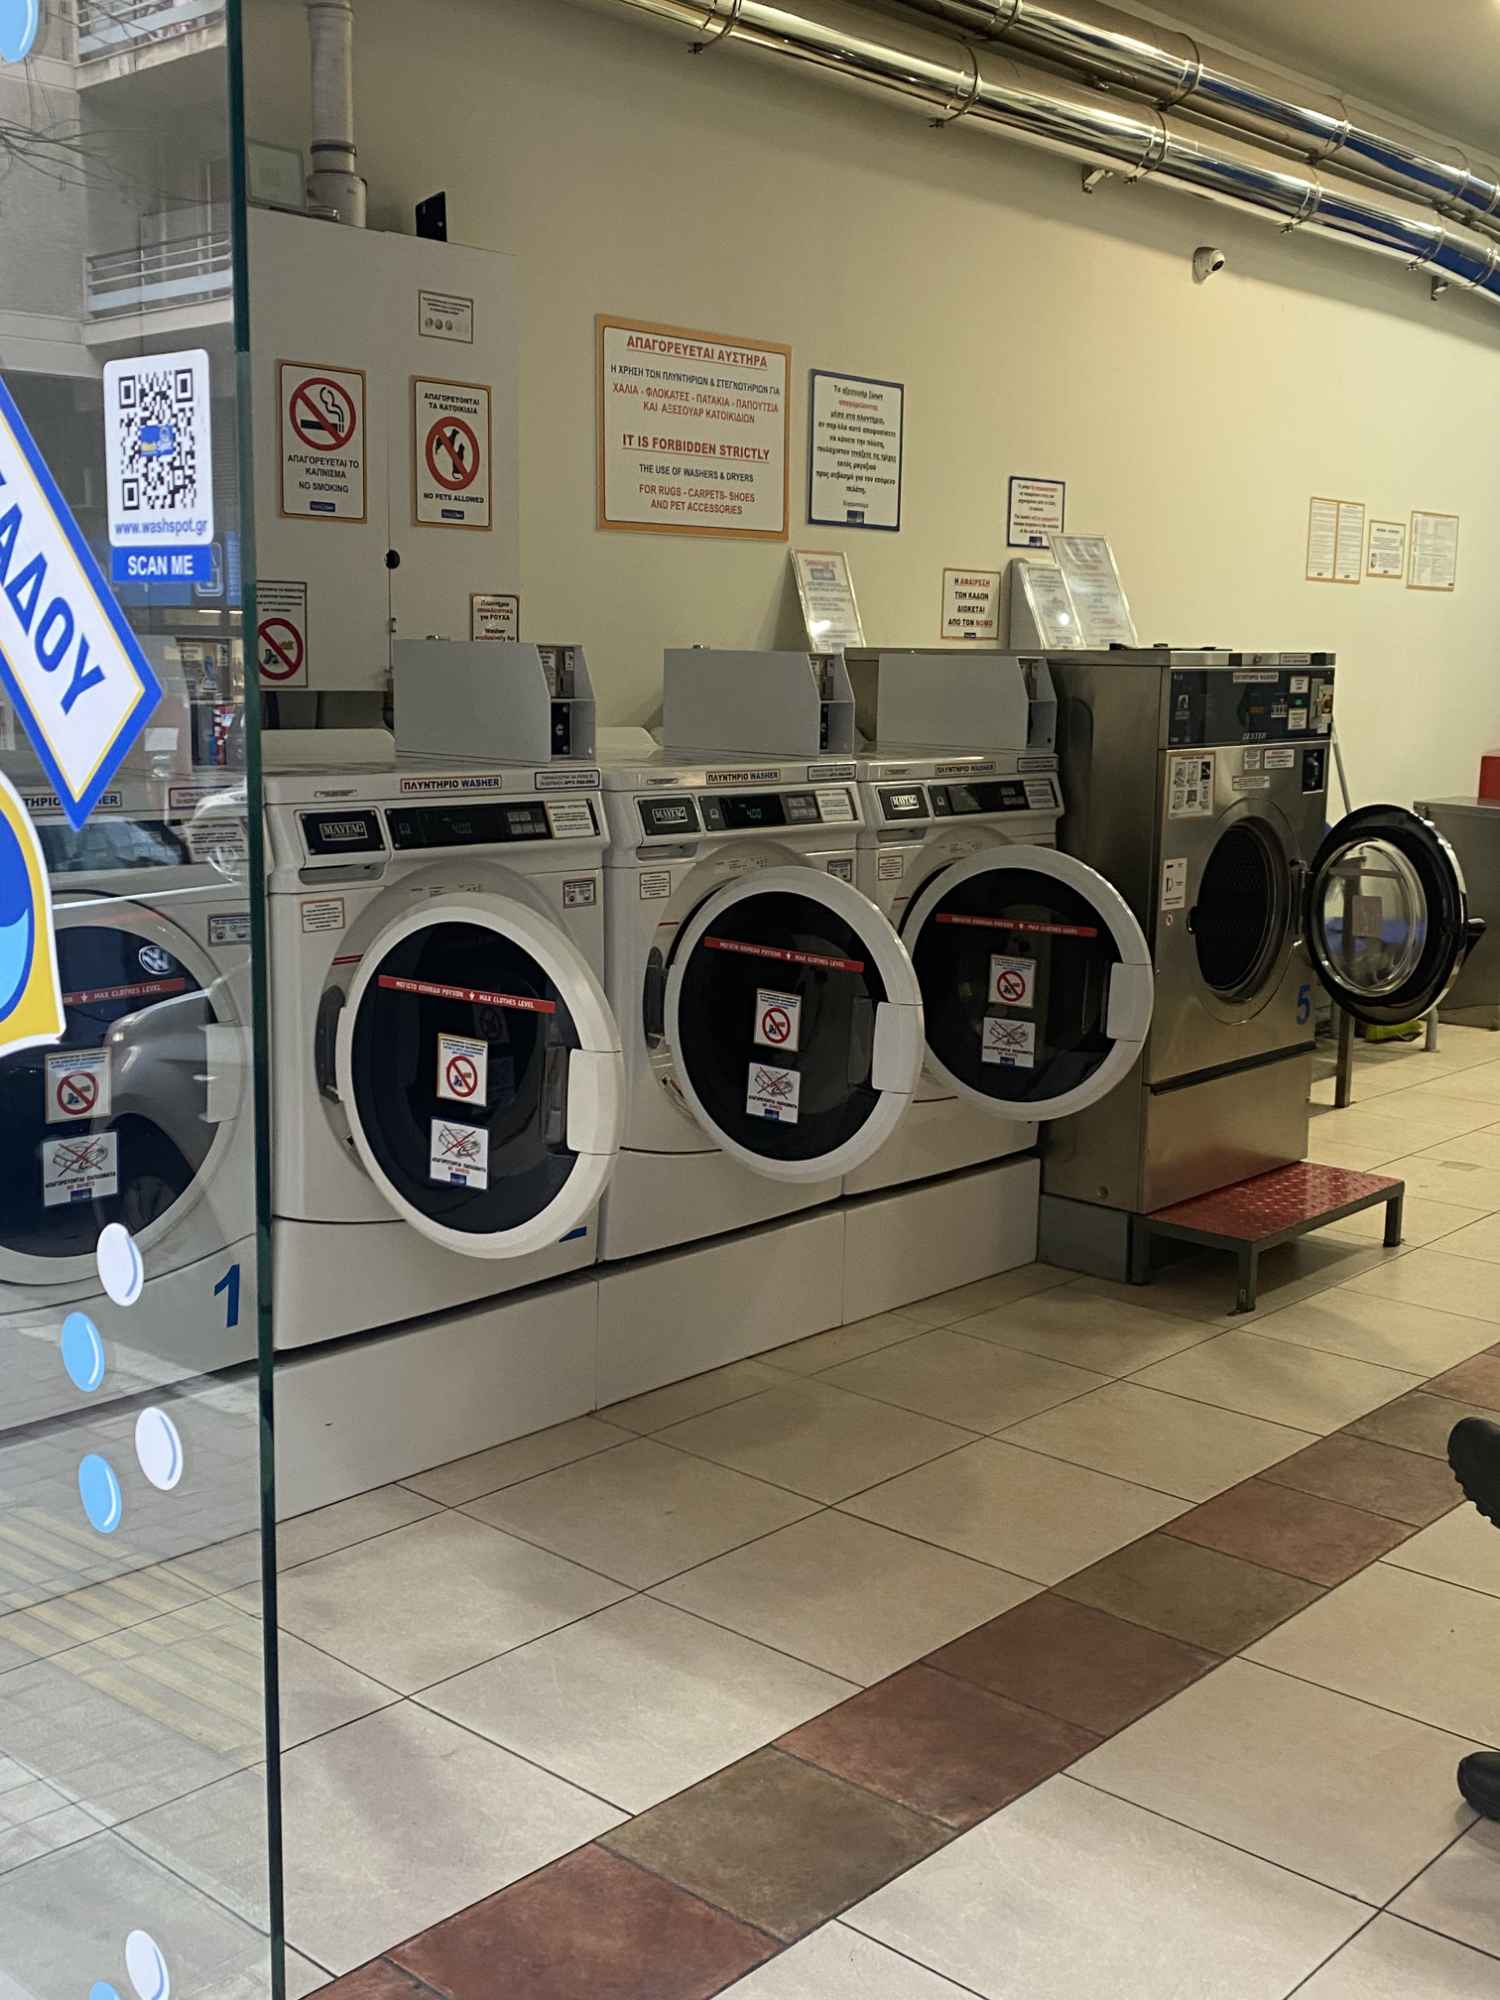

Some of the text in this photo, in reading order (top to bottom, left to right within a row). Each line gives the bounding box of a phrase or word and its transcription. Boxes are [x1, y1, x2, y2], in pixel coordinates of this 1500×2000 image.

[627, 335, 768, 368] ΑΠΑΓΟΡΕΥΕΤΑΙ ΑΥΣΤΗΡΑ
[611, 365, 617, 374] Η
[612, 383, 639, 395] ΧΑΛΙΑ
[645, 387, 690, 402] ΦΛΟΚΑΤΕΣ
[696, 393, 730, 407] ΠΑΤΑΚΙΑ
[643, 402, 658, 412] ΚΑΙ
[623, 433, 770, 461] IT IS FORBIDDEN STRICTLY
[287, 454, 360, 469] ΑΠΑΓΟΡΕΥΕΤΑΙ ΤΟ
[305, 467, 346, 479] ΚΑΠΝΙΣΜΑ
[640, 464, 754, 483] THE USE OF WASHERS & DRYERS
[298, 481, 349, 493] NO SMOKING
[639, 484, 657, 495] FOR
[659, 485, 681, 497] RUGS
[729, 493, 756, 503] SHOES
[651, 499, 744, 515] AND PET ACCESSORIES
[115, 518, 208, 537] www.washspot.gr
[127, 553, 195, 577] SCAN ME
[0, 472, 106, 716] ΑΔΟΥ
[403, 778, 500, 791] ΠΛΥΝΤΗΡΙΟ WASHER
[323, 823, 364, 835] MAYTAG
[94, 992, 109, 1000] MAX
[141, 984, 161, 993] LEVEL
[479, 994, 492, 1003] MAX
[517, 1000, 535, 1009] LEVEL
[1296, 983, 1312, 1025] 5
[214, 1263, 241, 1330] 1
